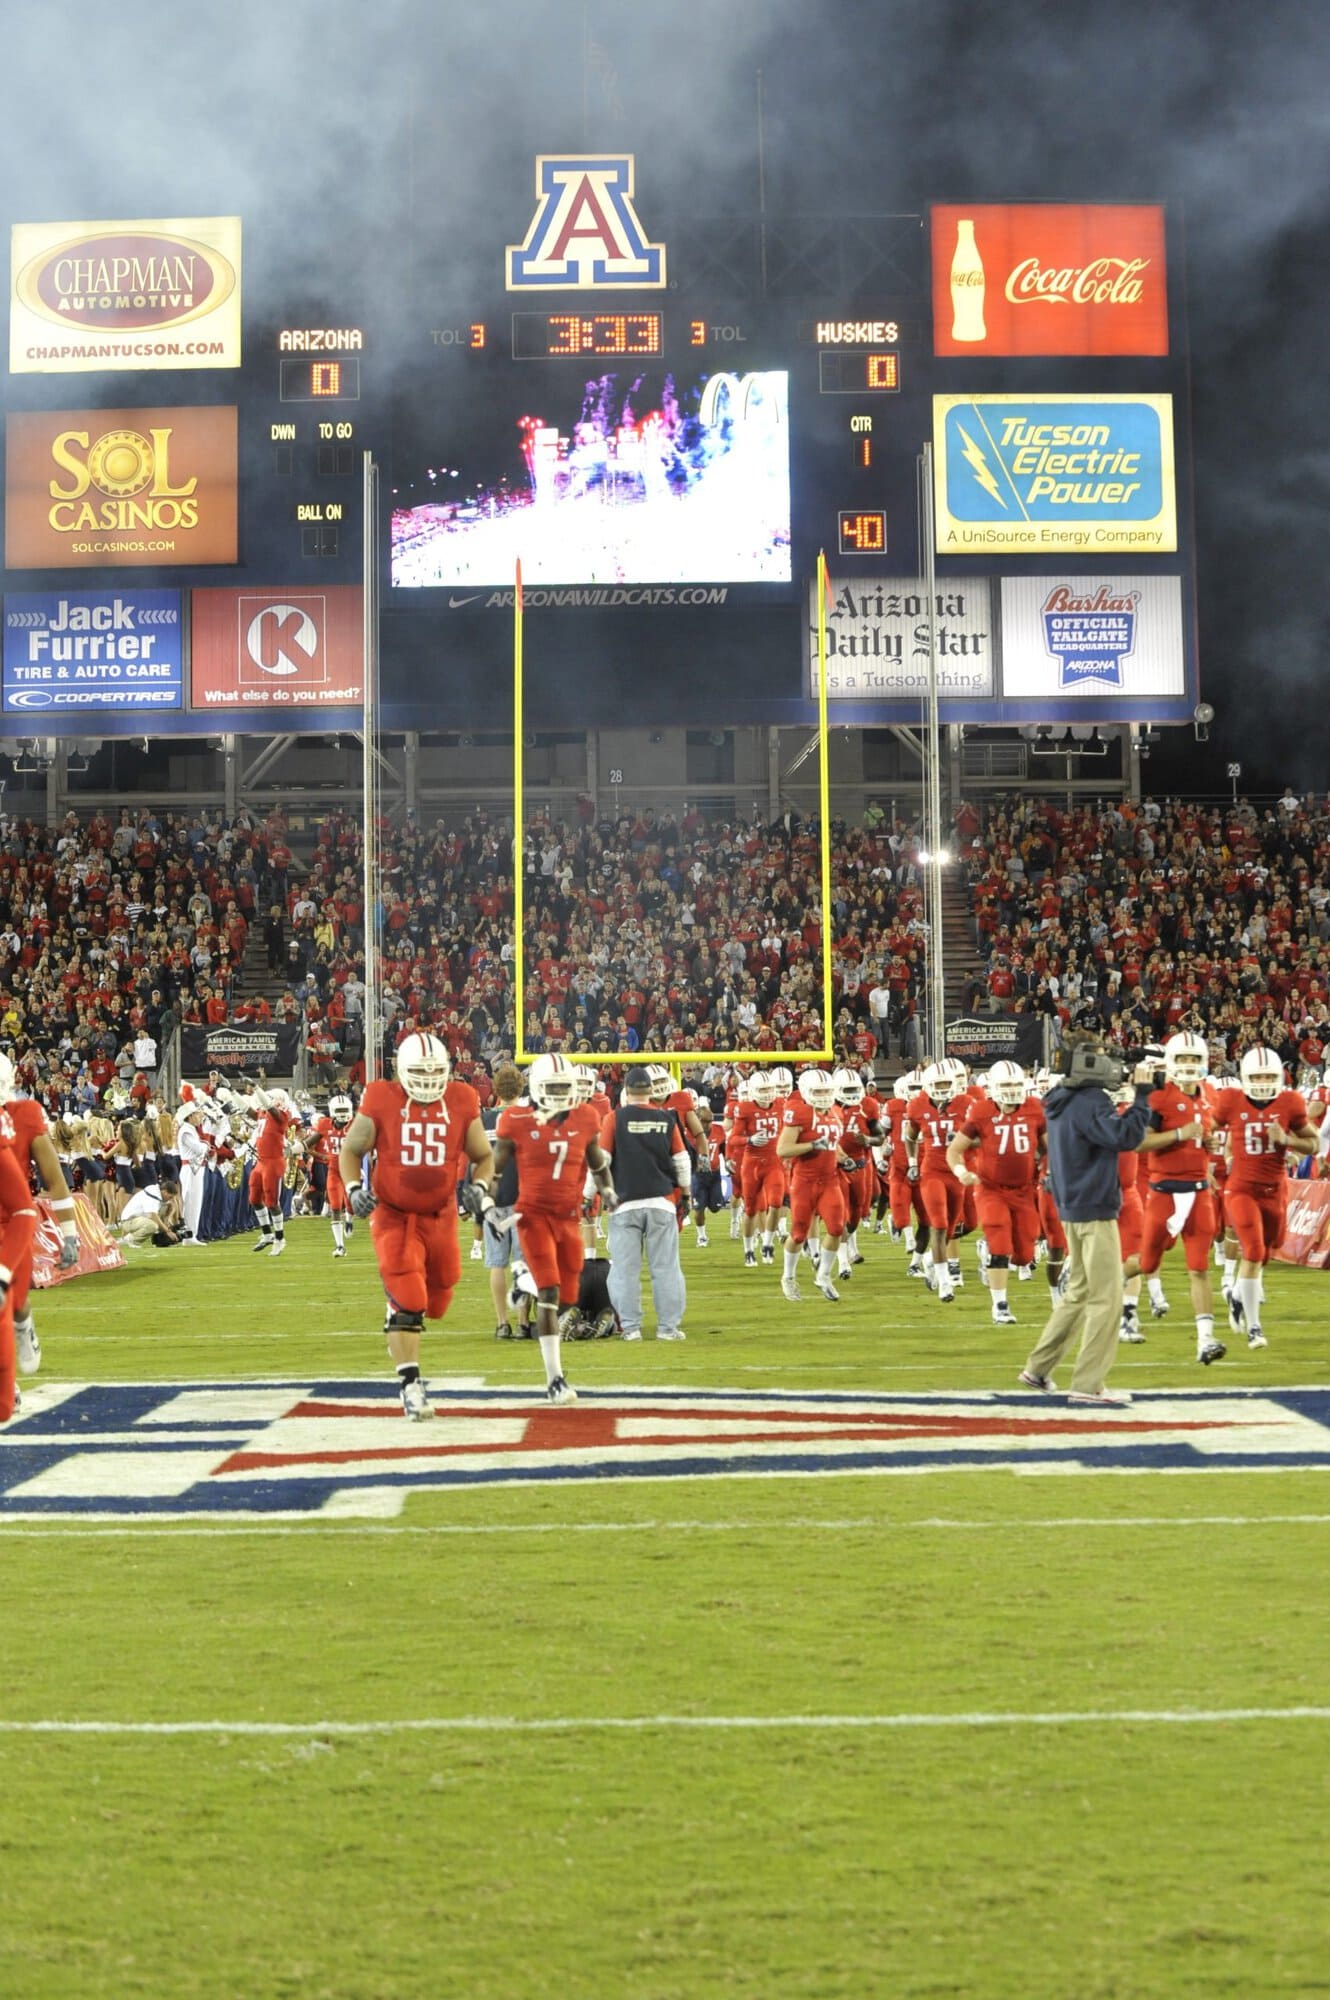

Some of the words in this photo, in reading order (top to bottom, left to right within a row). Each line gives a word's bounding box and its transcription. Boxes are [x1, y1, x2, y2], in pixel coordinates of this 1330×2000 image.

[54, 256, 197, 295] CHAPMAN
[1005, 258, 1150, 304] Coca-Cola
[58, 295, 193, 310] AUTOMOTIVE
[280, 329, 362, 351] ARIZONA
[431, 330, 465, 346] TOL
[471, 325, 485, 348] 3
[549, 316, 659, 353] 3:33
[691, 321, 705, 345] 3
[711, 326, 747, 341] TOL
[817, 322, 898, 343] HUSKIES
[26, 342, 225, 360] CHAPMANTUCSON.COM
[312, 363, 340, 396] 0
[867, 355, 897, 388] 0
[271, 424, 296, 441] DWN
[319, 424, 333, 440] TO
[336, 423, 353, 439] GO
[850, 416, 872, 432] QTR
[1000, 417, 1111, 446] Tucson
[50, 427, 199, 500] SOL
[1012, 447, 1141, 474] Electric
[1026, 476, 1141, 504] Power
[48, 499, 199, 533] CASINOS
[297, 504, 321, 521] BALL
[326, 504, 342, 520] ON
[843, 515, 882, 548] 40
[946, 531, 958, 543] A
[962, 529, 1037, 543] UniSource
[1041, 529, 1090, 544] Energy
[1095, 529, 1163, 544] Company
[71, 541, 175, 553] SOLCASINOS.COM
[485, 588, 728, 608] ARZONAWILDCATS.COM
[830, 585, 967, 619] Arizona
[49, 599, 135, 632] Jack
[1051, 617, 1128, 630] OFFICIAL
[29, 630, 156, 662] Furrier
[809, 624, 904, 665] Daily
[1051, 630, 1128, 642] TAILGATE
[1052, 642, 1128, 652] HEADQUARTERS
[14, 666, 52, 680] TIRE
[57, 666, 69, 679] &
[76, 665, 121, 679] AUTO
[126, 664, 171, 677] CARE
[1065, 659, 1116, 670] ARIZONA
[846, 677, 856, 688] a
[863, 671, 928, 688] Tucson
[204, 688, 241, 702] What
[243, 688, 269, 701] else
[273, 687, 290, 700] do
[293, 690, 316, 703] you
[319, 687, 360, 700] need?
[610, 769, 623, 783] 28
[1227, 763, 1241, 777] 29
[947, 1026, 987, 1034] AMERICAN
[988, 1025, 1017, 1033] FAMILY
[207, 1036, 247, 1045] AMERICAN
[248, 1036, 277, 1044] FAMILY
[627, 1120, 669, 1134] ESPN
[401, 1122, 447, 1167] 55
[995, 1124, 1031, 1155] 76
[549, 1140, 568, 1180] 7
